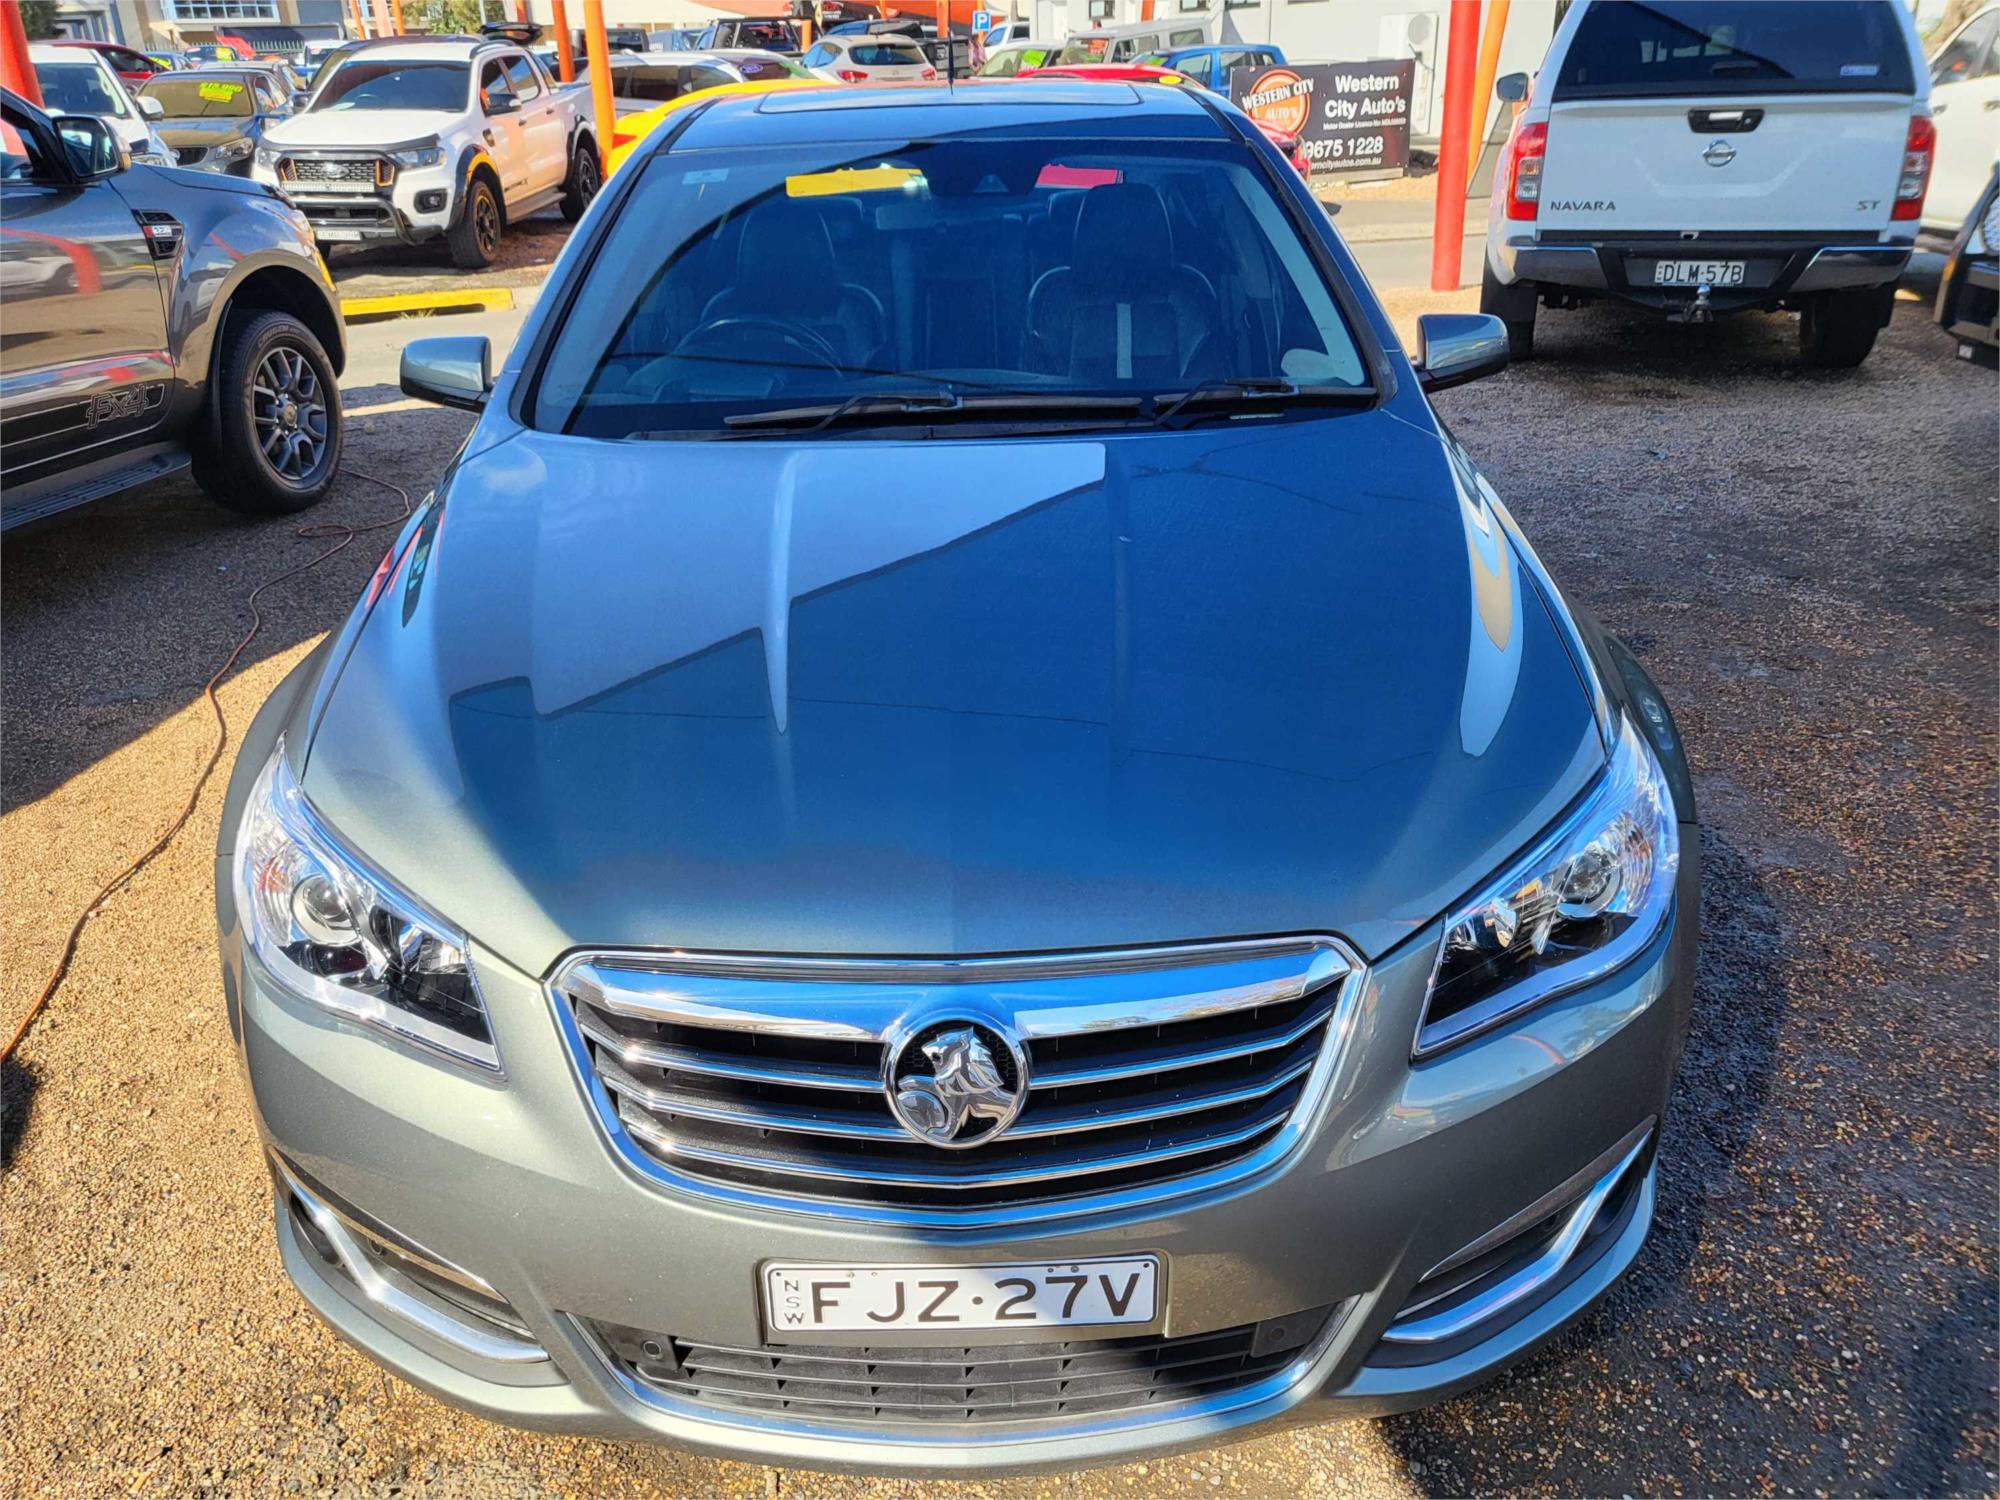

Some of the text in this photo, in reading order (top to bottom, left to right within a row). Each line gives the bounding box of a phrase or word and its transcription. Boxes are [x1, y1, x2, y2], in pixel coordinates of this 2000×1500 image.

[977, 13, 988, 28] P
[1335, 74, 1399, 93] Western
[1241, 78, 1314, 111] WESTERN CITY
[1265, 106, 1298, 120] AUTO'S
[1324, 95, 1406, 120] City Auto's
[1304, 136, 1384, 159] 9675 1228
[1550, 200, 1617, 211] NAVARA
[1857, 200, 1881, 211] ST
[85, 384, 149, 430] FX4
[784, 1280, 804, 1325] NSW
